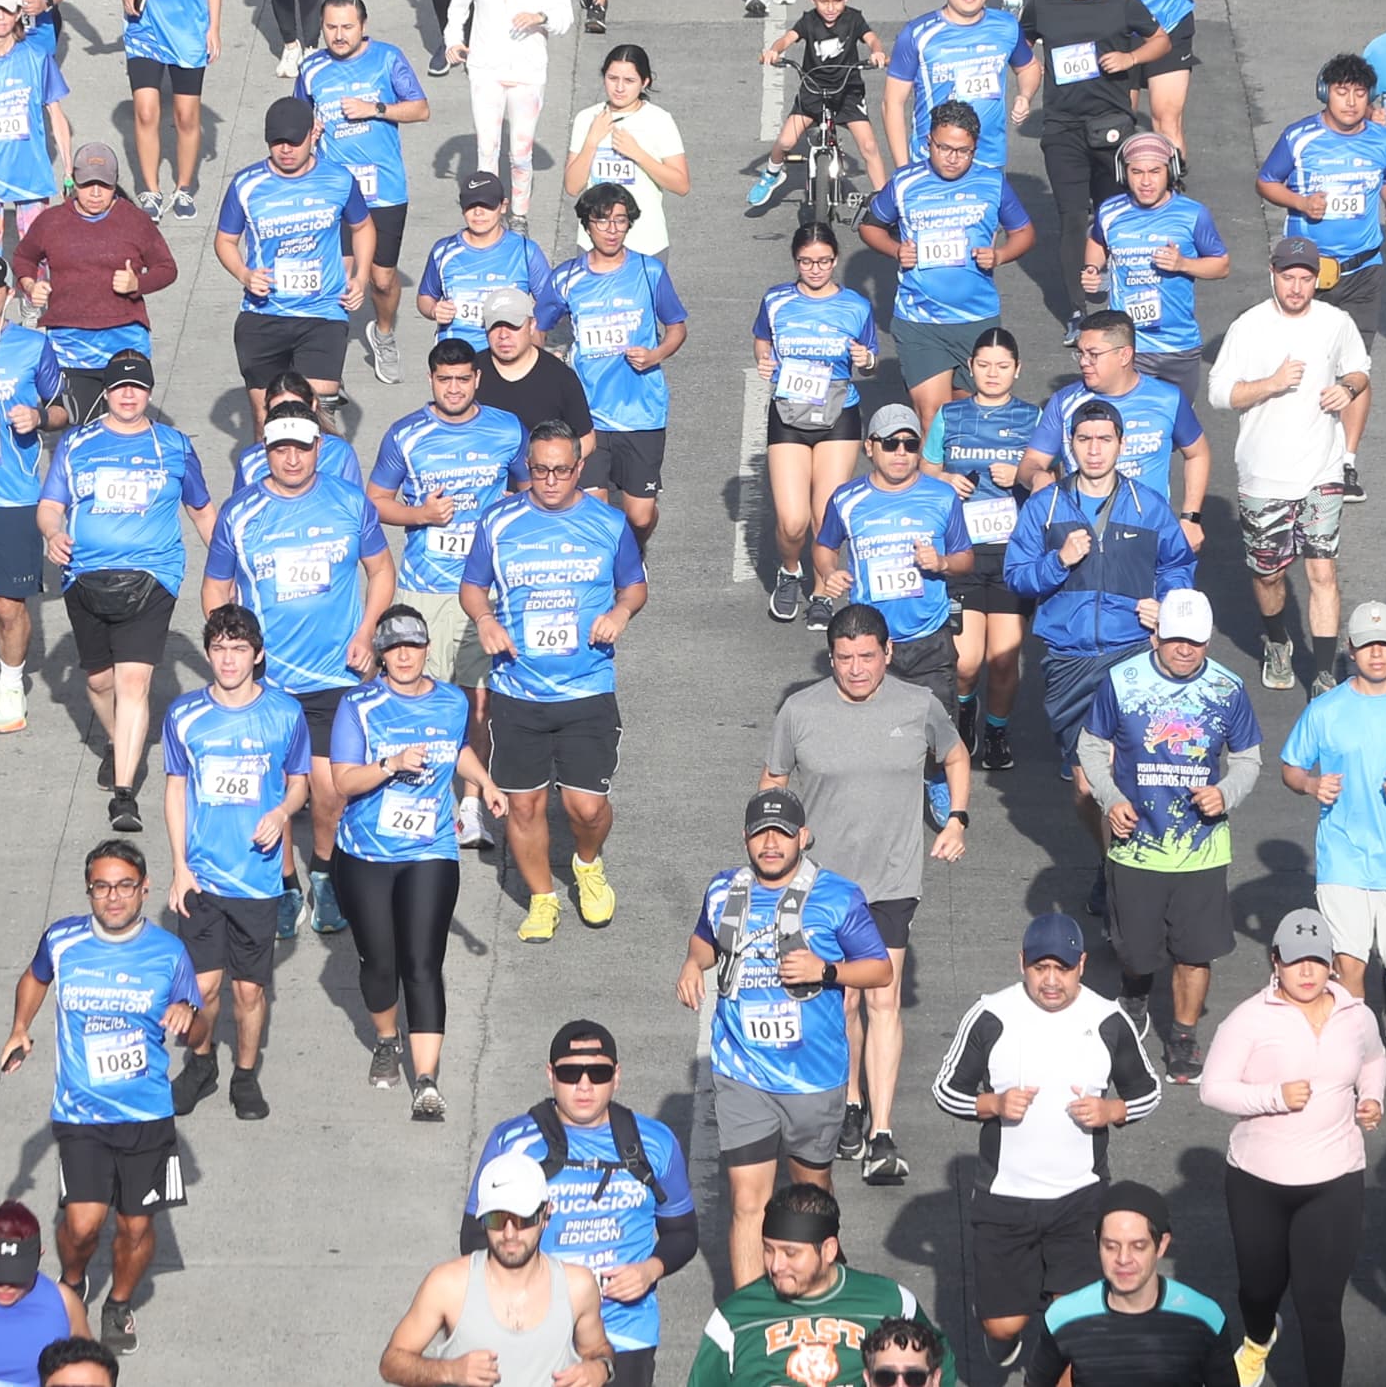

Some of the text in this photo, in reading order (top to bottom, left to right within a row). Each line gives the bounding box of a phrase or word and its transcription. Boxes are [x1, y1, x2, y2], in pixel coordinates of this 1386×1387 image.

[1062, 59, 1090, 74] 060
[965, 77, 991, 93] 234
[596, 162, 630, 177] 1194
[1330, 197, 1358, 212] 058
[924, 243, 960, 258] 1031
[281, 271, 319, 290] 1238
[1128, 304, 1156, 320] 1038
[585, 330, 624, 345] 1143
[785, 374, 822, 397] 1091
[950, 446, 1024, 460] Runners
[106, 483, 138, 500] 042
[973, 514, 1013, 533] 1063
[438, 536, 465, 552] 121
[288, 566, 321, 582] 266
[505, 558, 583, 574] MOVIMIENTO
[508, 569, 595, 587] EDUCACIÓN
[876, 573, 917, 591] 1159
[530, 590, 571, 599] PRIMERA
[525, 597, 575, 610] EDICIÓN
[536, 630, 569, 646] 269
[215, 775, 249, 795] 268
[1137, 773, 1179, 787] SENDEROS
[392, 811, 426, 832] 267
[747, 1018, 796, 1041] 1015
[96, 1050, 144, 1074] 1083
[565, 1218, 616, 1232] PRIMERA
[559, 1228, 621, 1245] EDICIÓN
[765, 1317, 865, 1356] EAST
